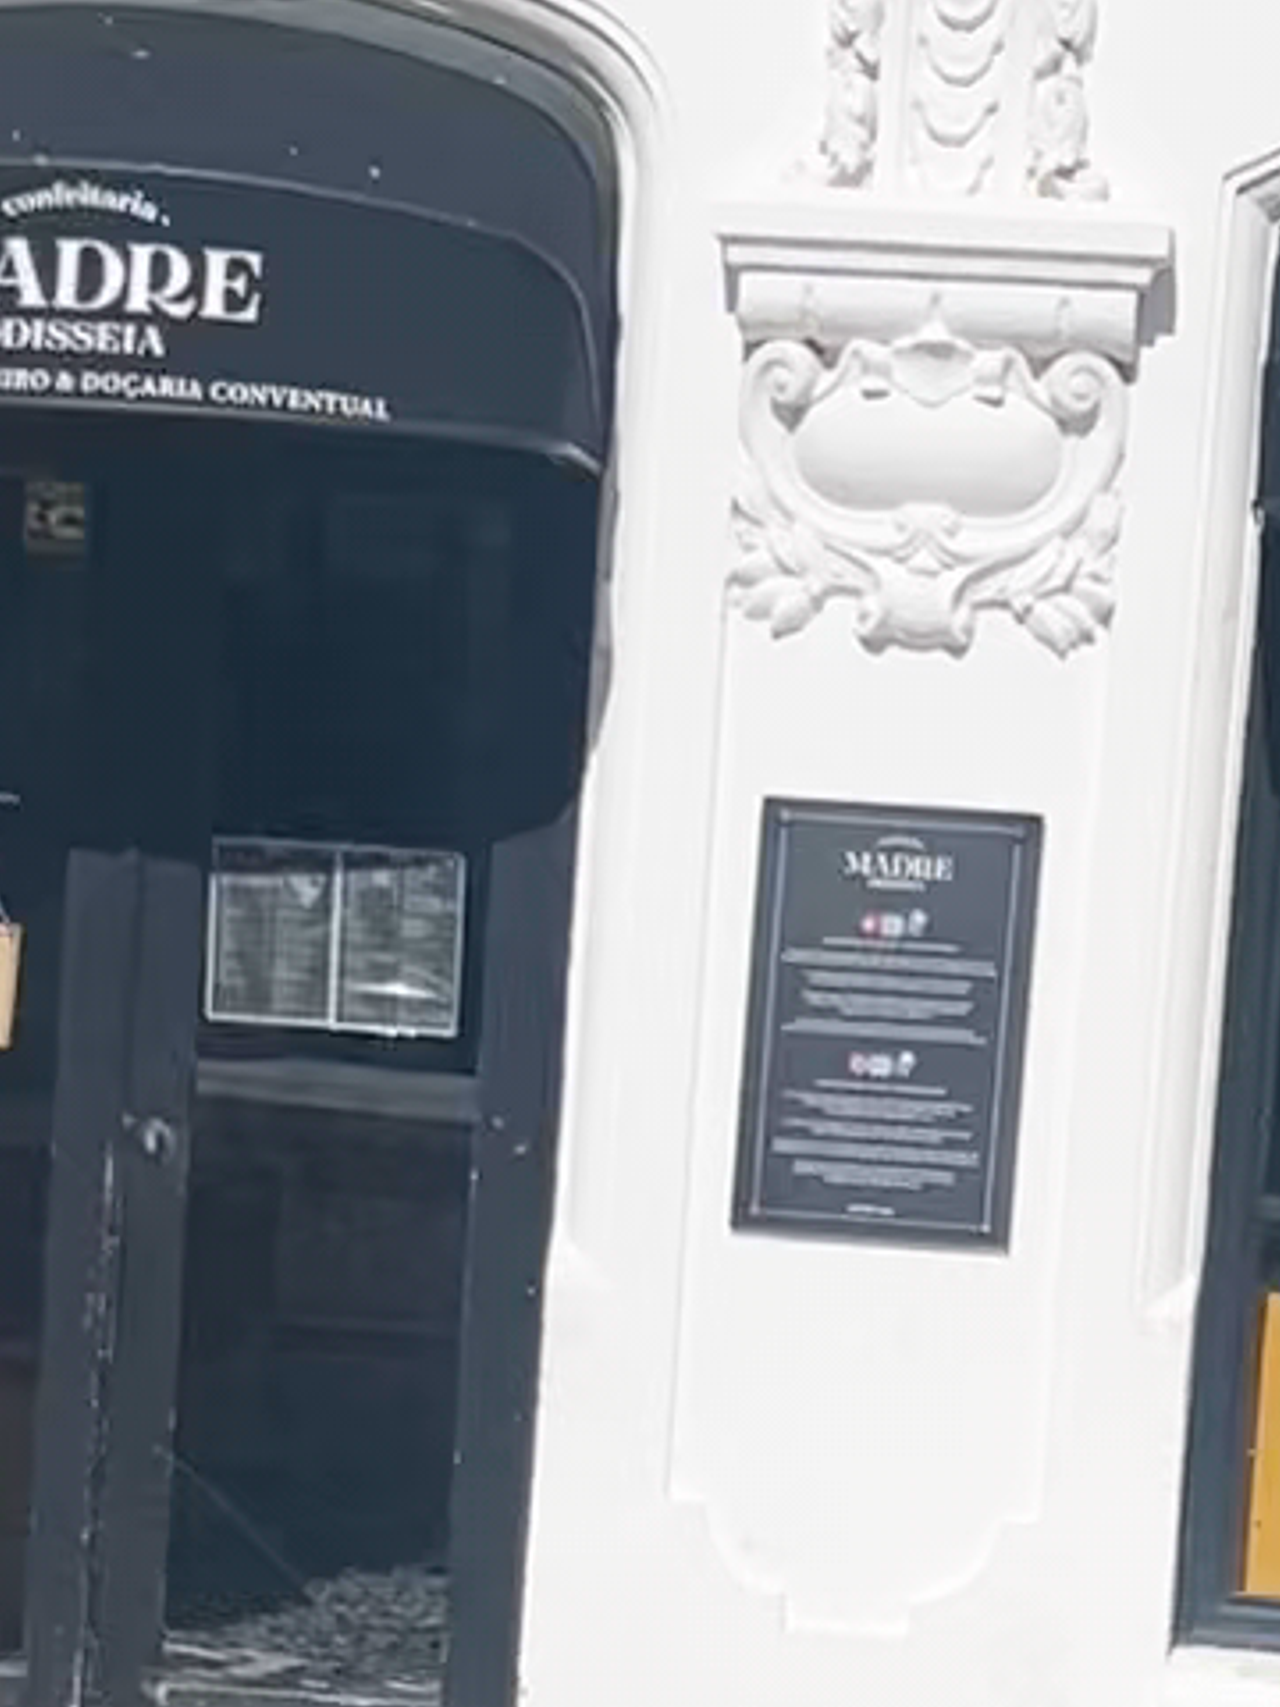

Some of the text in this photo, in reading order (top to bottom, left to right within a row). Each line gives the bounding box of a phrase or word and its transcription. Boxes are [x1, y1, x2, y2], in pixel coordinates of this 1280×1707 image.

[1, 179, 158, 223] confeitaria
[54, 368, 74, 392] &
[81, 370, 202, 401] DOÇARIA
[210, 381, 391, 423] CONVENTUAL
